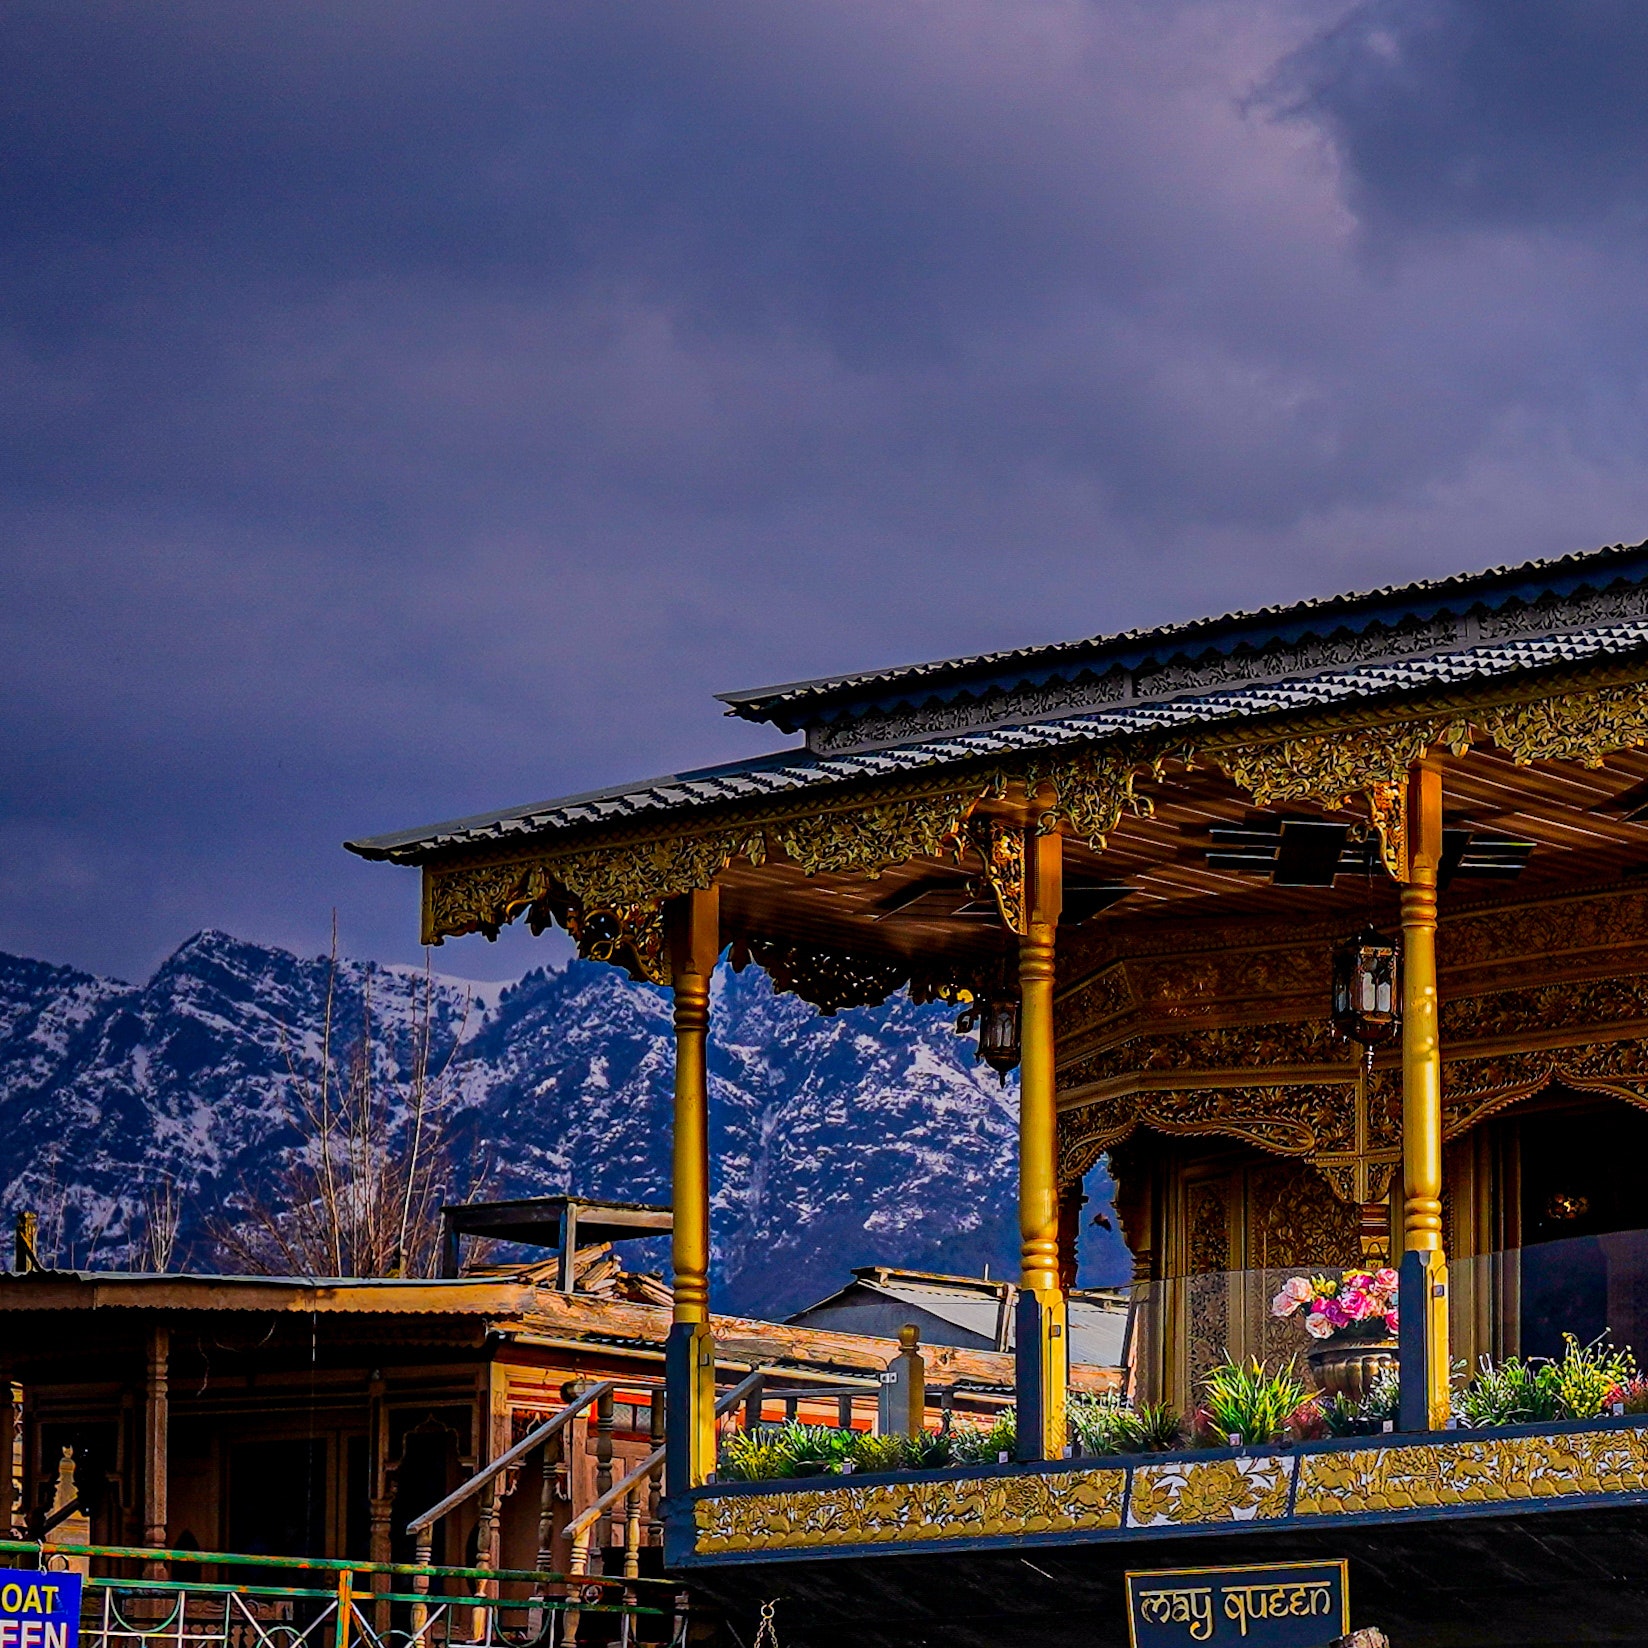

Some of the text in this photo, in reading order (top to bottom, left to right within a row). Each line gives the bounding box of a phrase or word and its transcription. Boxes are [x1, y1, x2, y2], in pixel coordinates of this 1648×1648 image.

[1, 1583, 60, 1614] OAT
[1139, 1581, 1332, 1641] may queen
